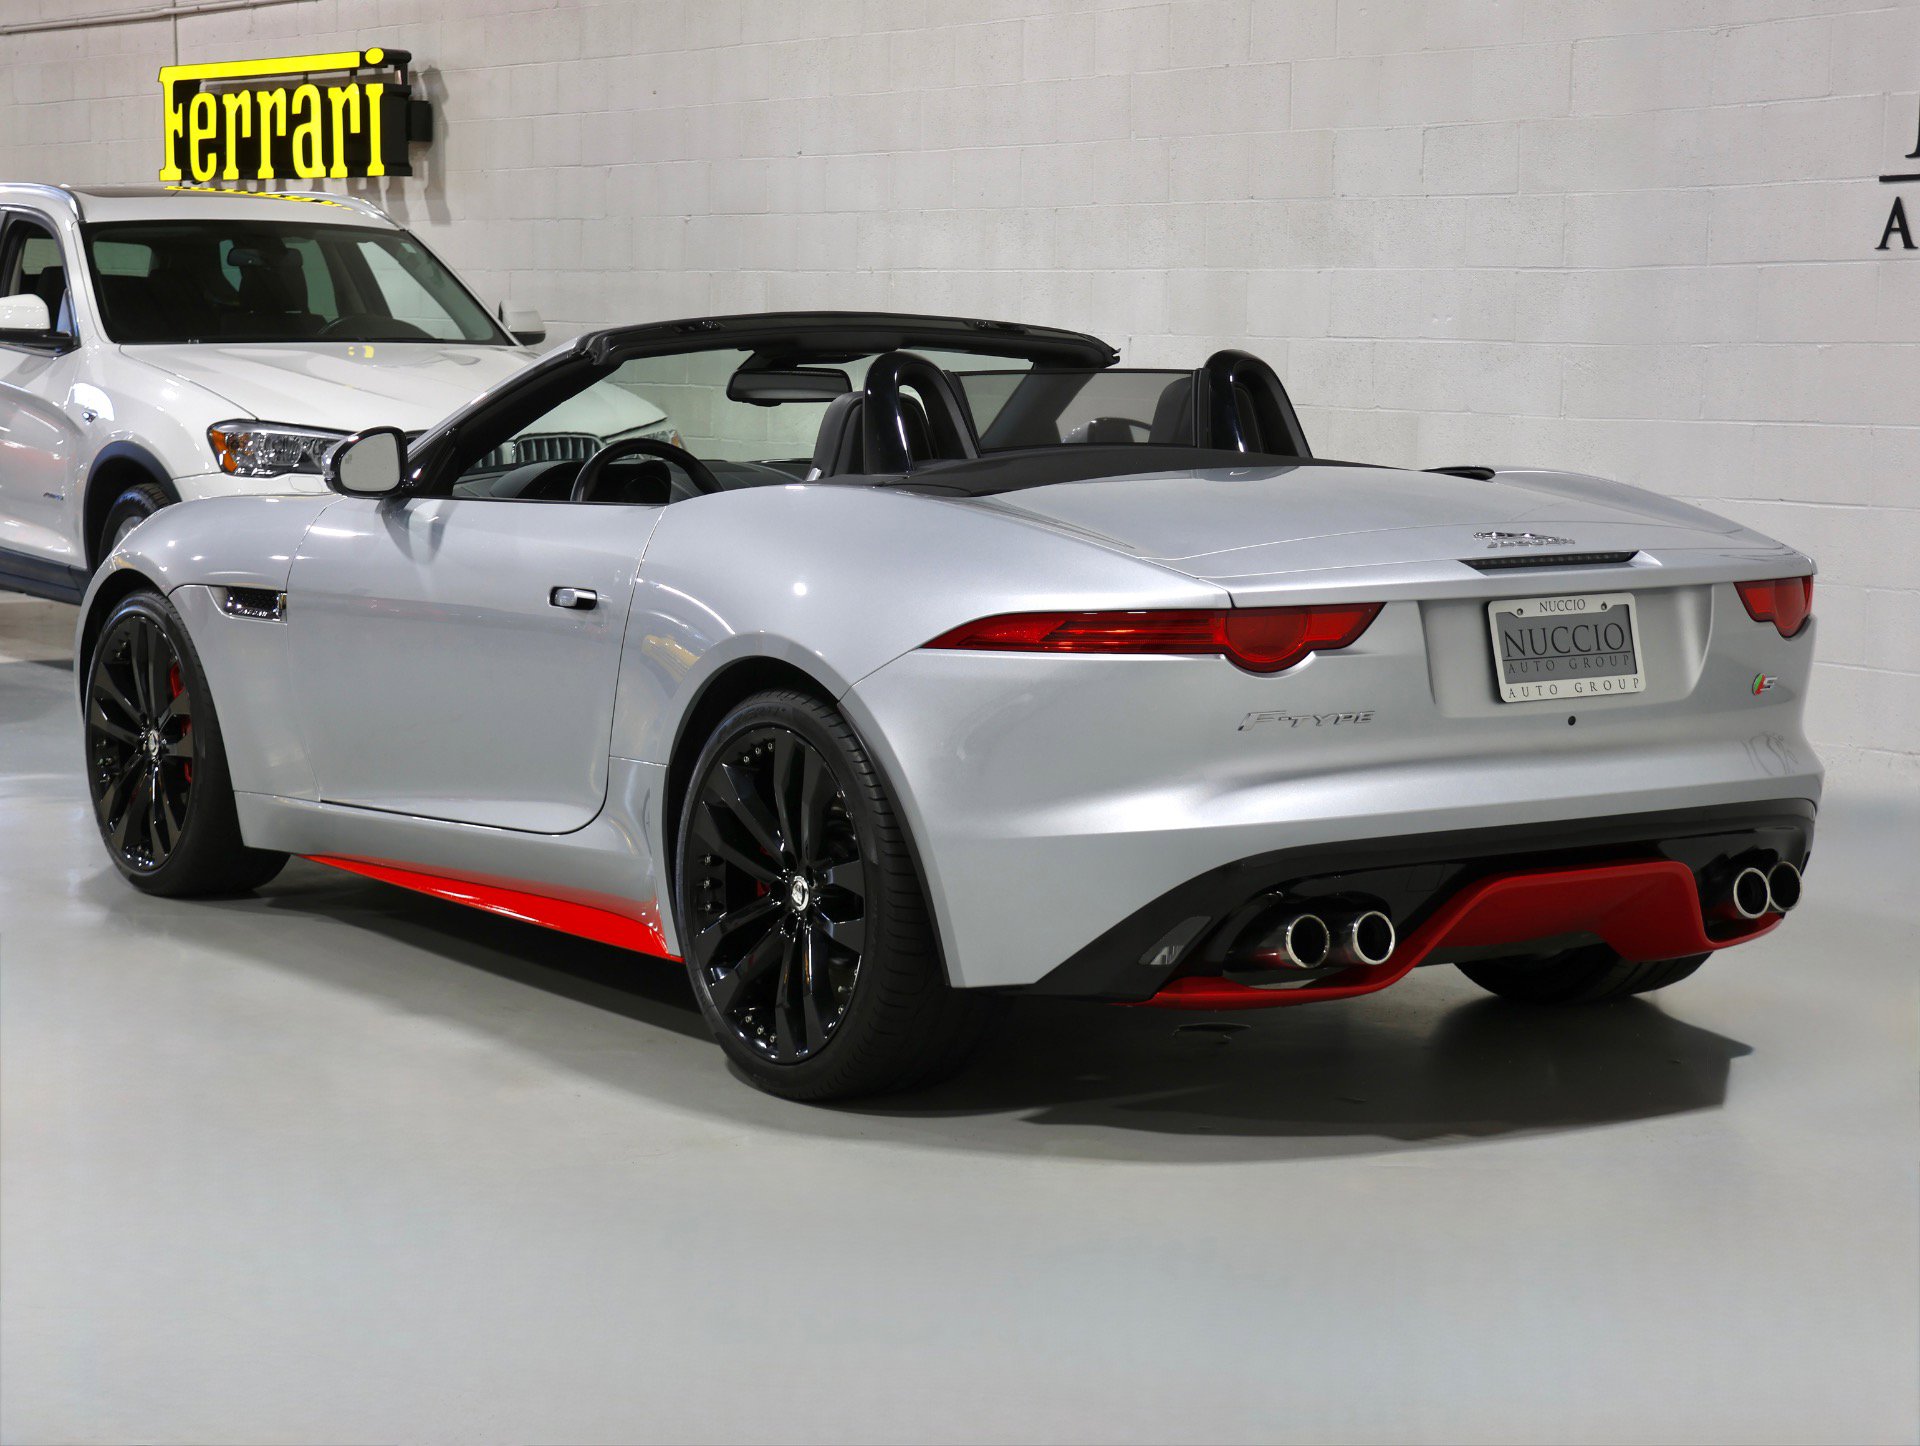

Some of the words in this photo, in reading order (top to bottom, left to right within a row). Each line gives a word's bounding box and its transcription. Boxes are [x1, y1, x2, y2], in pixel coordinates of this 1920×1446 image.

[159, 47, 385, 182] Ferrari
[1539, 599, 1586, 613] NUCCIO
[1503, 622, 1625, 658] NUCCIO
[1508, 660, 1555, 674] AUTO
[1568, 654, 1630, 670] GROUP
[1508, 684, 1558, 699] AUTO
[1574, 677, 1640, 694] GROUP
